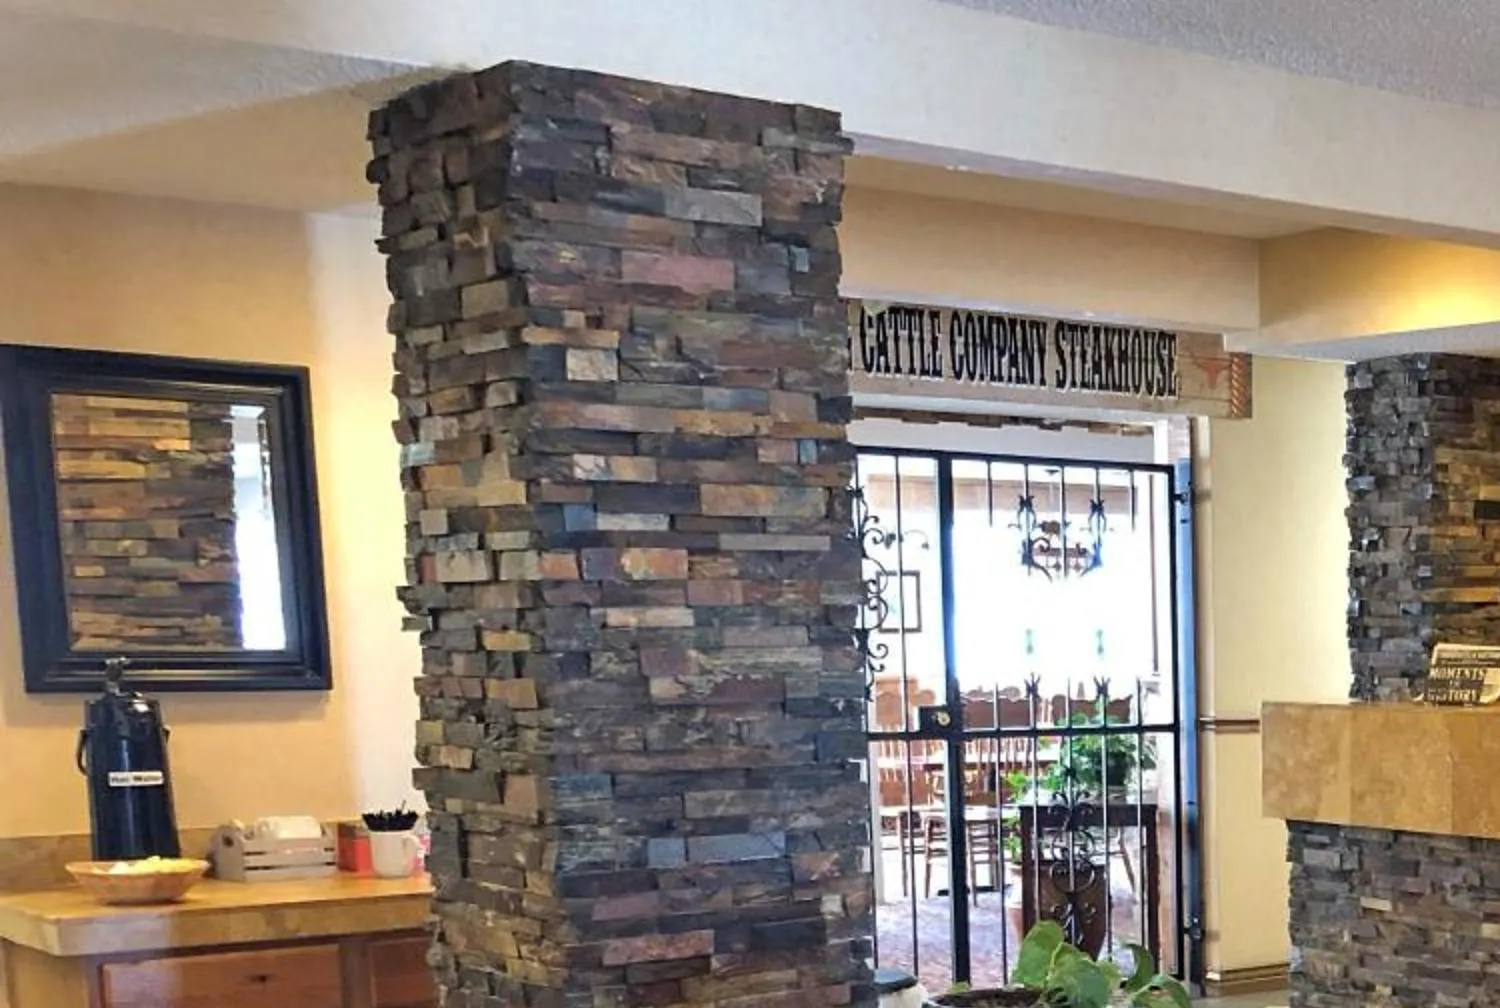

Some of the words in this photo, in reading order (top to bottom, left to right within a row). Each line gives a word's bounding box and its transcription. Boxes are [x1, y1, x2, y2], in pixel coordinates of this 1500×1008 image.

[860, 305, 943, 377] CATTLE
[949, 309, 1048, 387] COMPANY
[1055, 320, 1177, 397] STEAKHOUSE
